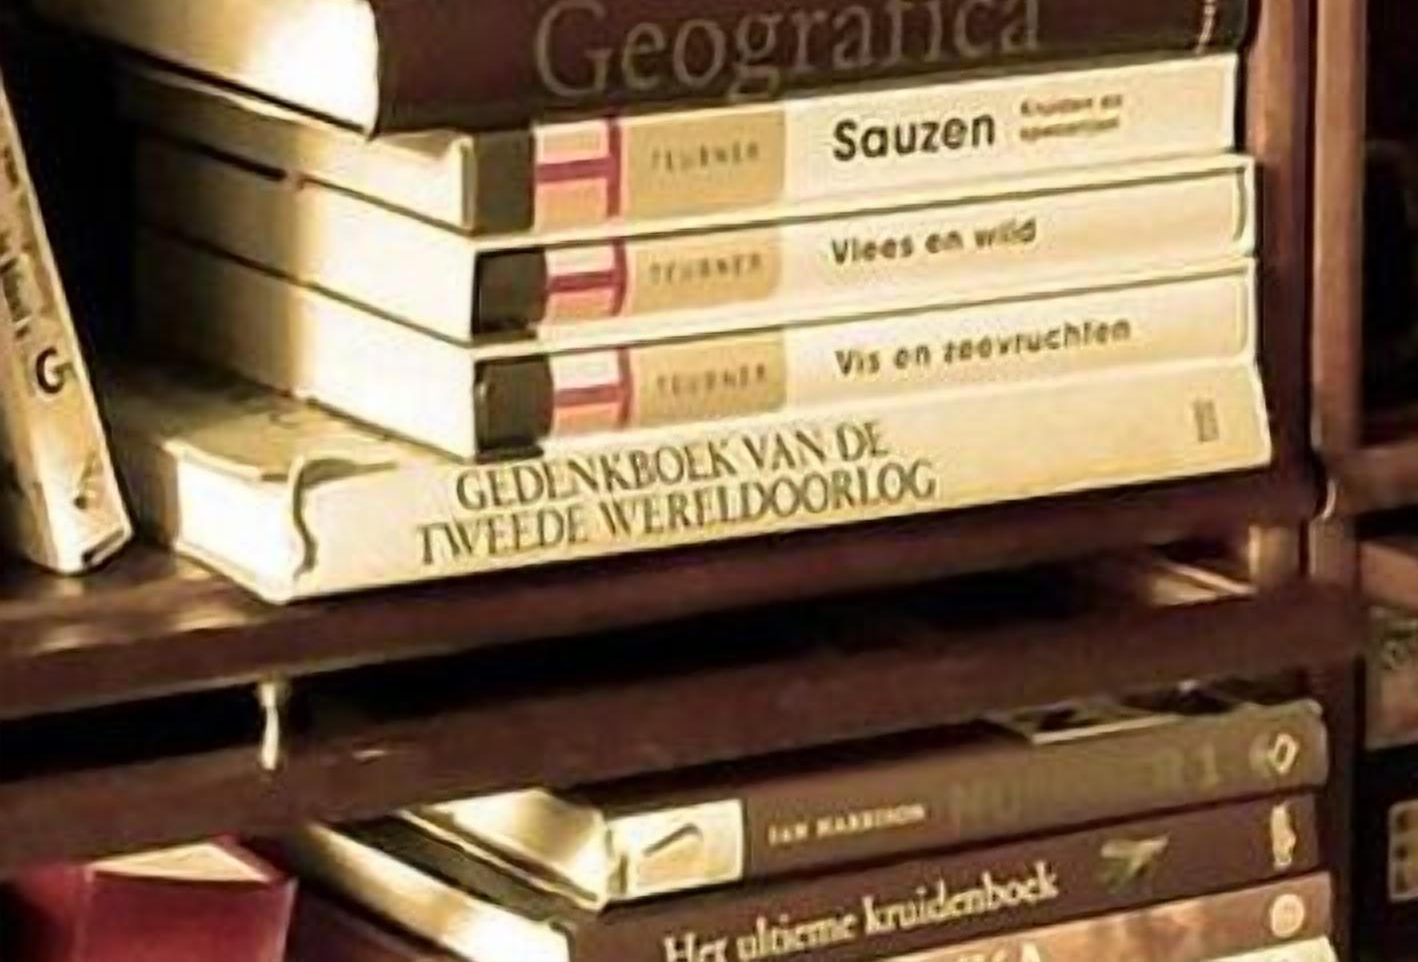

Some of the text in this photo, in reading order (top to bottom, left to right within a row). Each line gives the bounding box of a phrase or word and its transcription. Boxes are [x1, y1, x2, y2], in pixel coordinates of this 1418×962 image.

[832, 111, 996, 163] Sauzen
[831, 230, 915, 265] Vlees
[925, 228, 964, 256] en
[973, 216, 1038, 248] wild
[835, 346, 882, 378] Vis
[893, 342, 932, 371] en
[942, 317, 1133, 365] zeevruchten
[455, 418, 891, 513] GEDENKBOEK VAN DE
[415, 459, 938, 566] TWEEDE WERELDOORLOG
